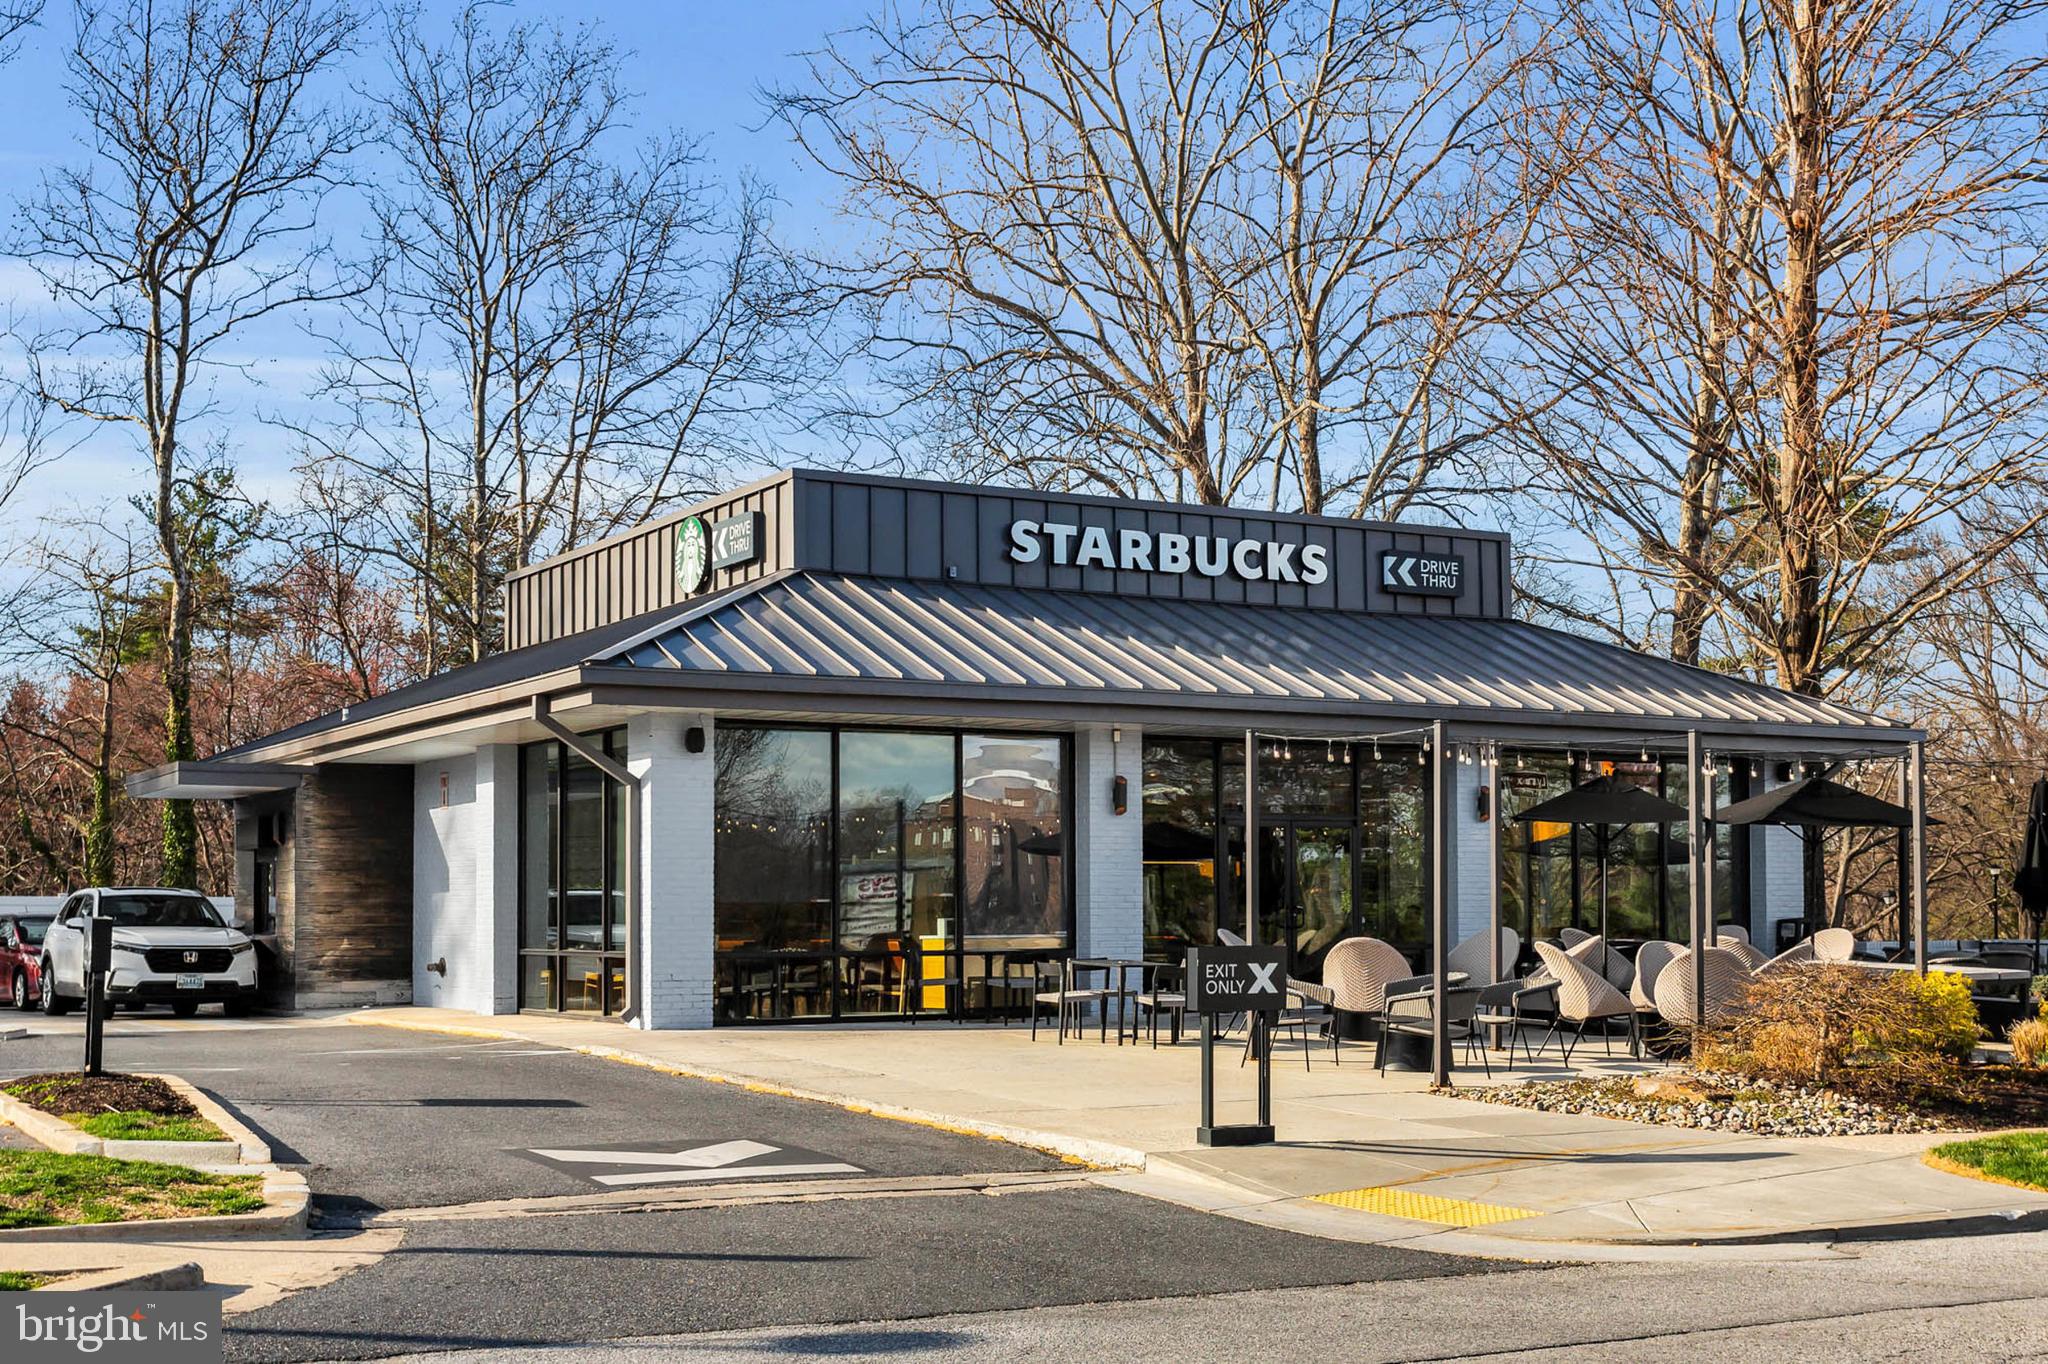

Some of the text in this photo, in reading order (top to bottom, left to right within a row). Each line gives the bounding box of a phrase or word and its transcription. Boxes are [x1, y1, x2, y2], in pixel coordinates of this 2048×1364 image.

[729, 520, 751, 540] DRIVE
[729, 536, 750, 555] THRU
[1010, 519, 1328, 585] STARBUCKS
[1420, 559, 1459, 575] DRIVE
[1421, 573, 1456, 589] THRU
[1205, 963, 1238, 978] EXIT
[1205, 979, 1246, 995] ONLY
